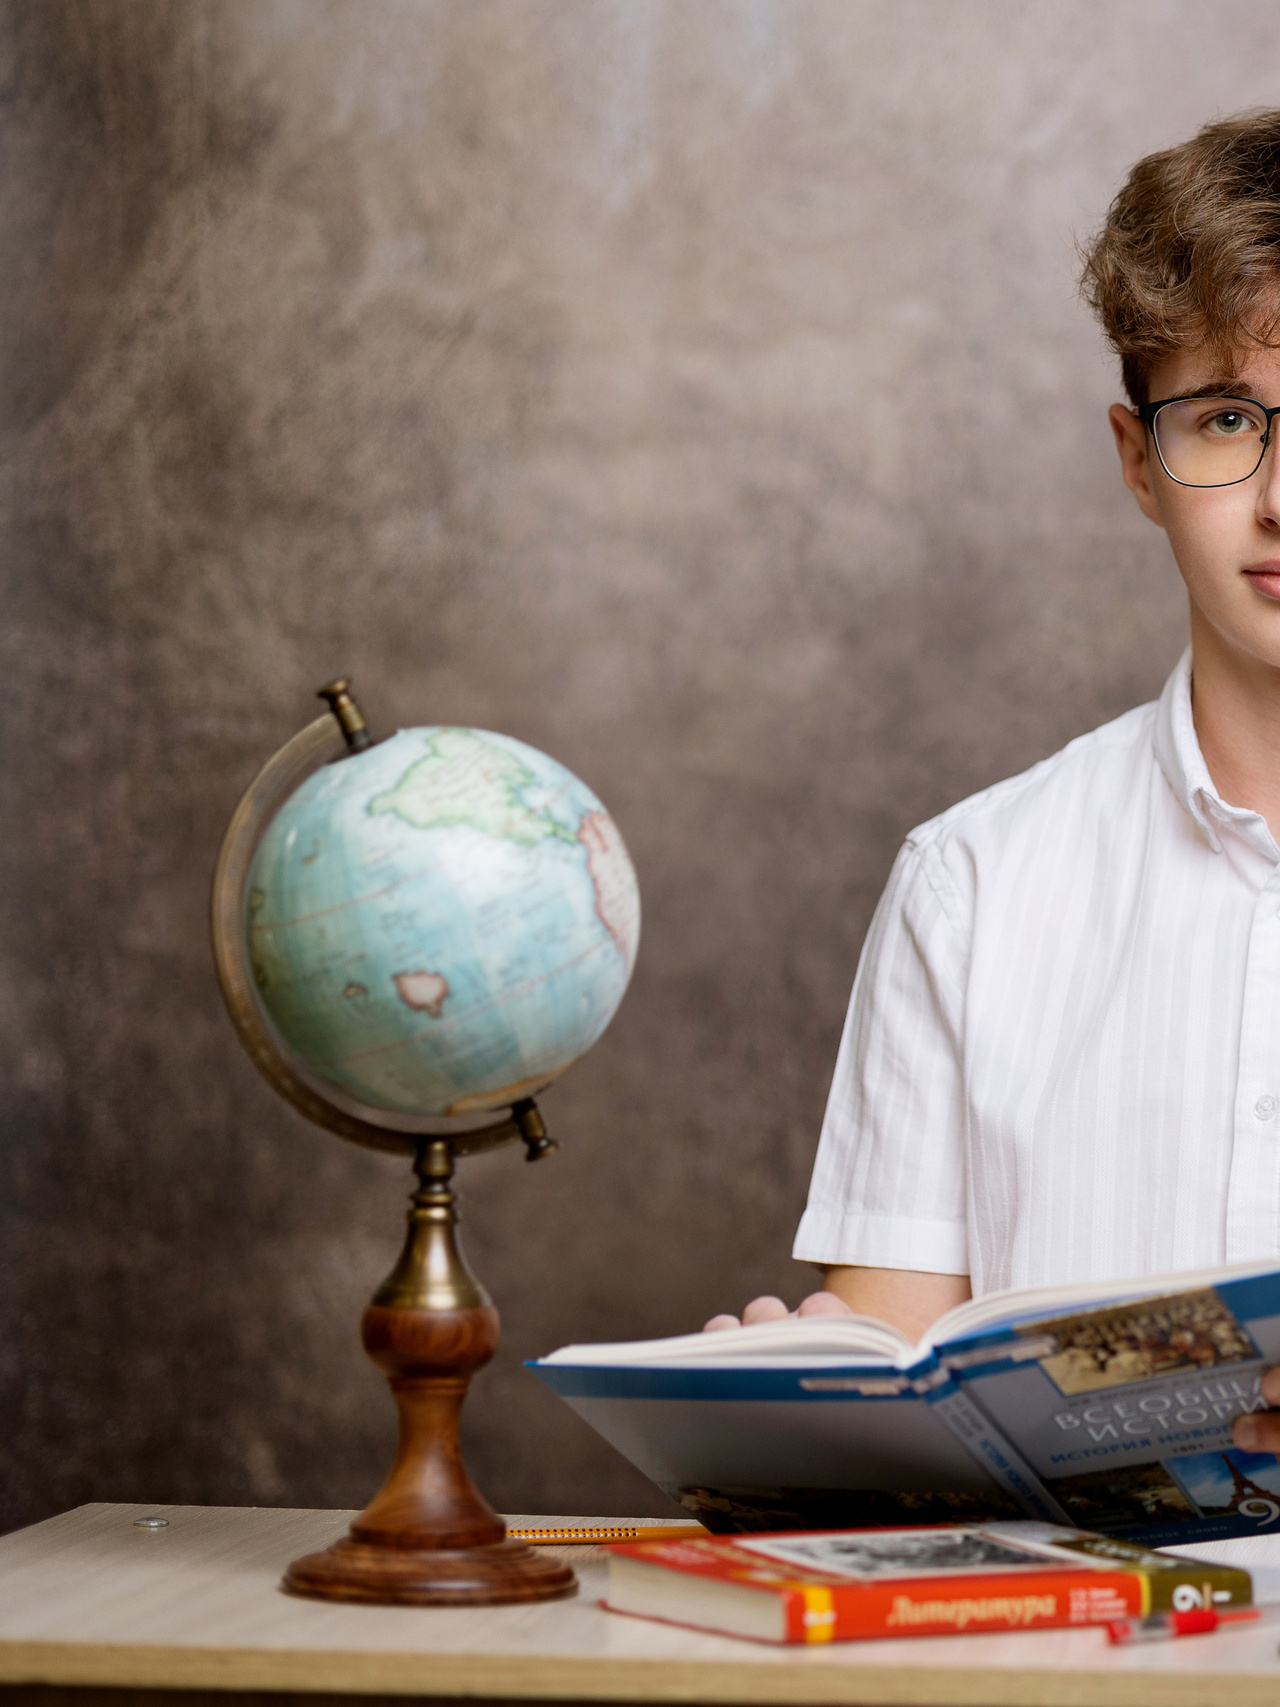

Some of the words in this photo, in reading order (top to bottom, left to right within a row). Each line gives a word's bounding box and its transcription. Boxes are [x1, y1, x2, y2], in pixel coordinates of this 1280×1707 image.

[1087, 1394, 1269, 1441] ИСТОРИ
[1050, 1437, 1152, 1464] ИСТОРИЯ
[1158, 1424, 1232, 1444] НОВОГ
[1237, 1498, 1280, 1527] 9
[886, 1594, 1057, 1629] Литература
